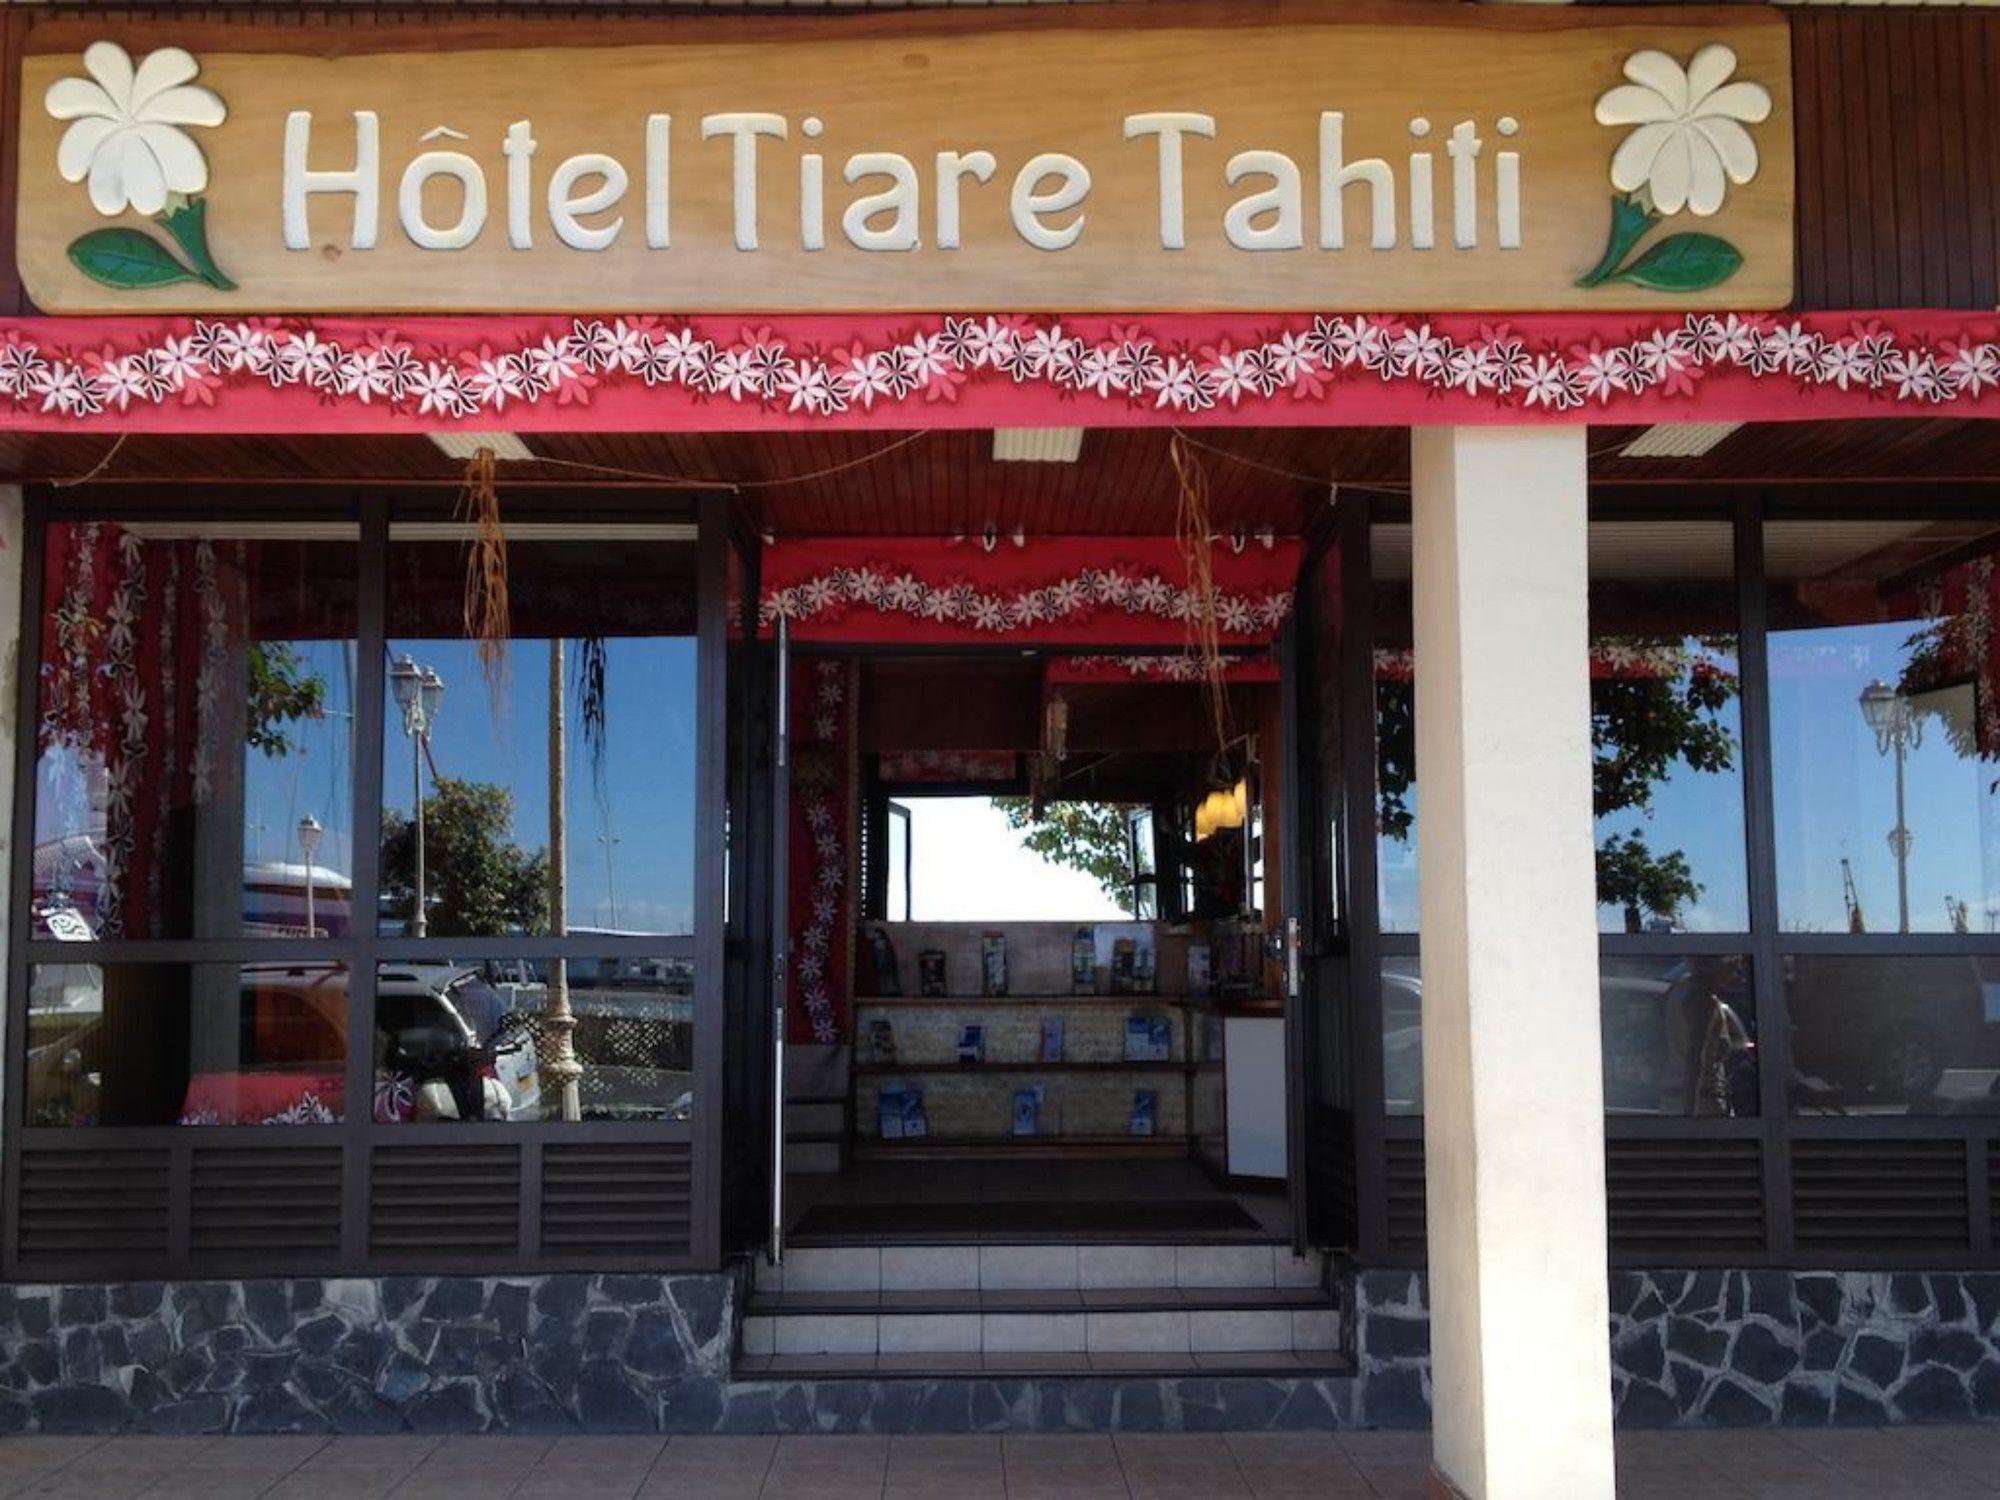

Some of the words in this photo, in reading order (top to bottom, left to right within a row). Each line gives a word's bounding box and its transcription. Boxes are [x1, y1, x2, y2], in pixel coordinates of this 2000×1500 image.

[282, 109, 672, 251] Hôtel
[701, 112, 1092, 252] Tiare
[1123, 110, 1523, 252] Tahiti
